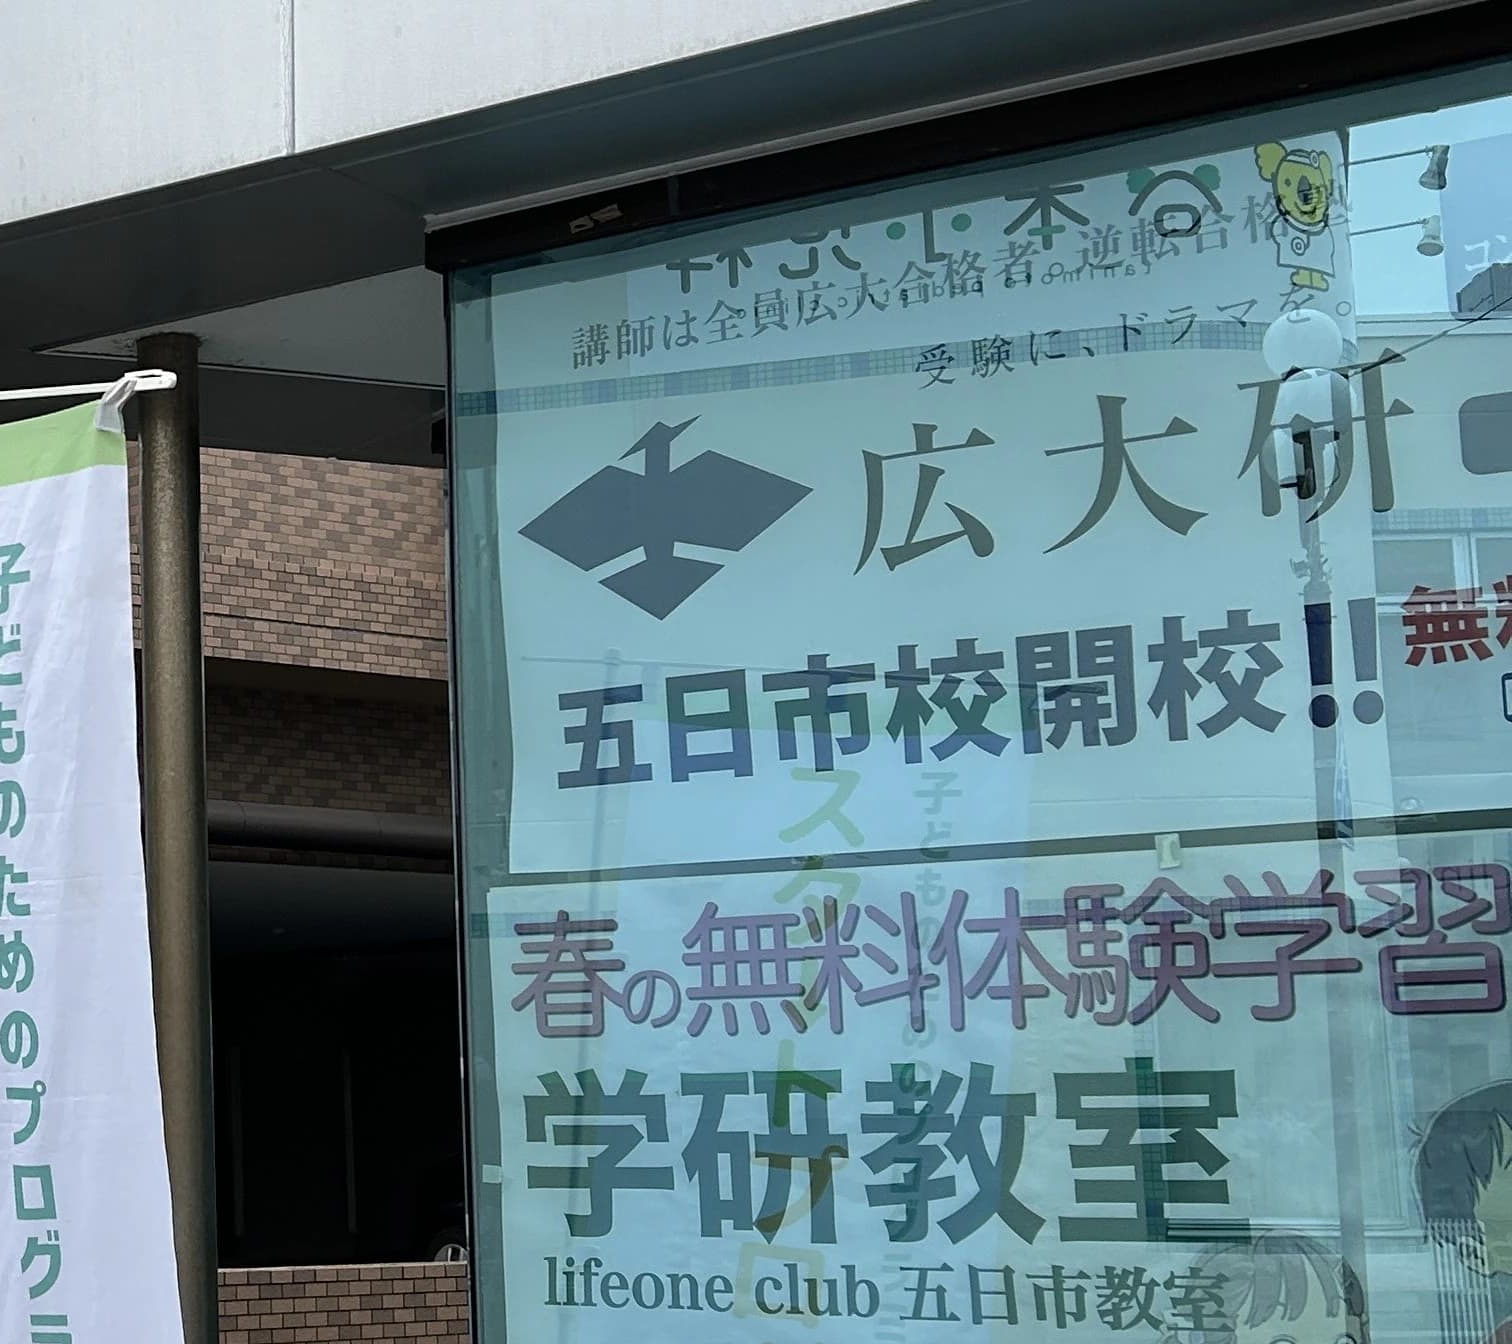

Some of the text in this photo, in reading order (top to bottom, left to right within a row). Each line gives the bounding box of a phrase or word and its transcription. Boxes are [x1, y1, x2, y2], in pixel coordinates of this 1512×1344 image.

[853, 346, 1415, 576] 広大研
[1400, 574, 1512, 667] 無
[510, 862, 1512, 1039] 春の無料体験学習
[523, 1056, 1252, 1246] 学研教室
[543, 1255, 1236, 1333] lifeone club 五日市教室
